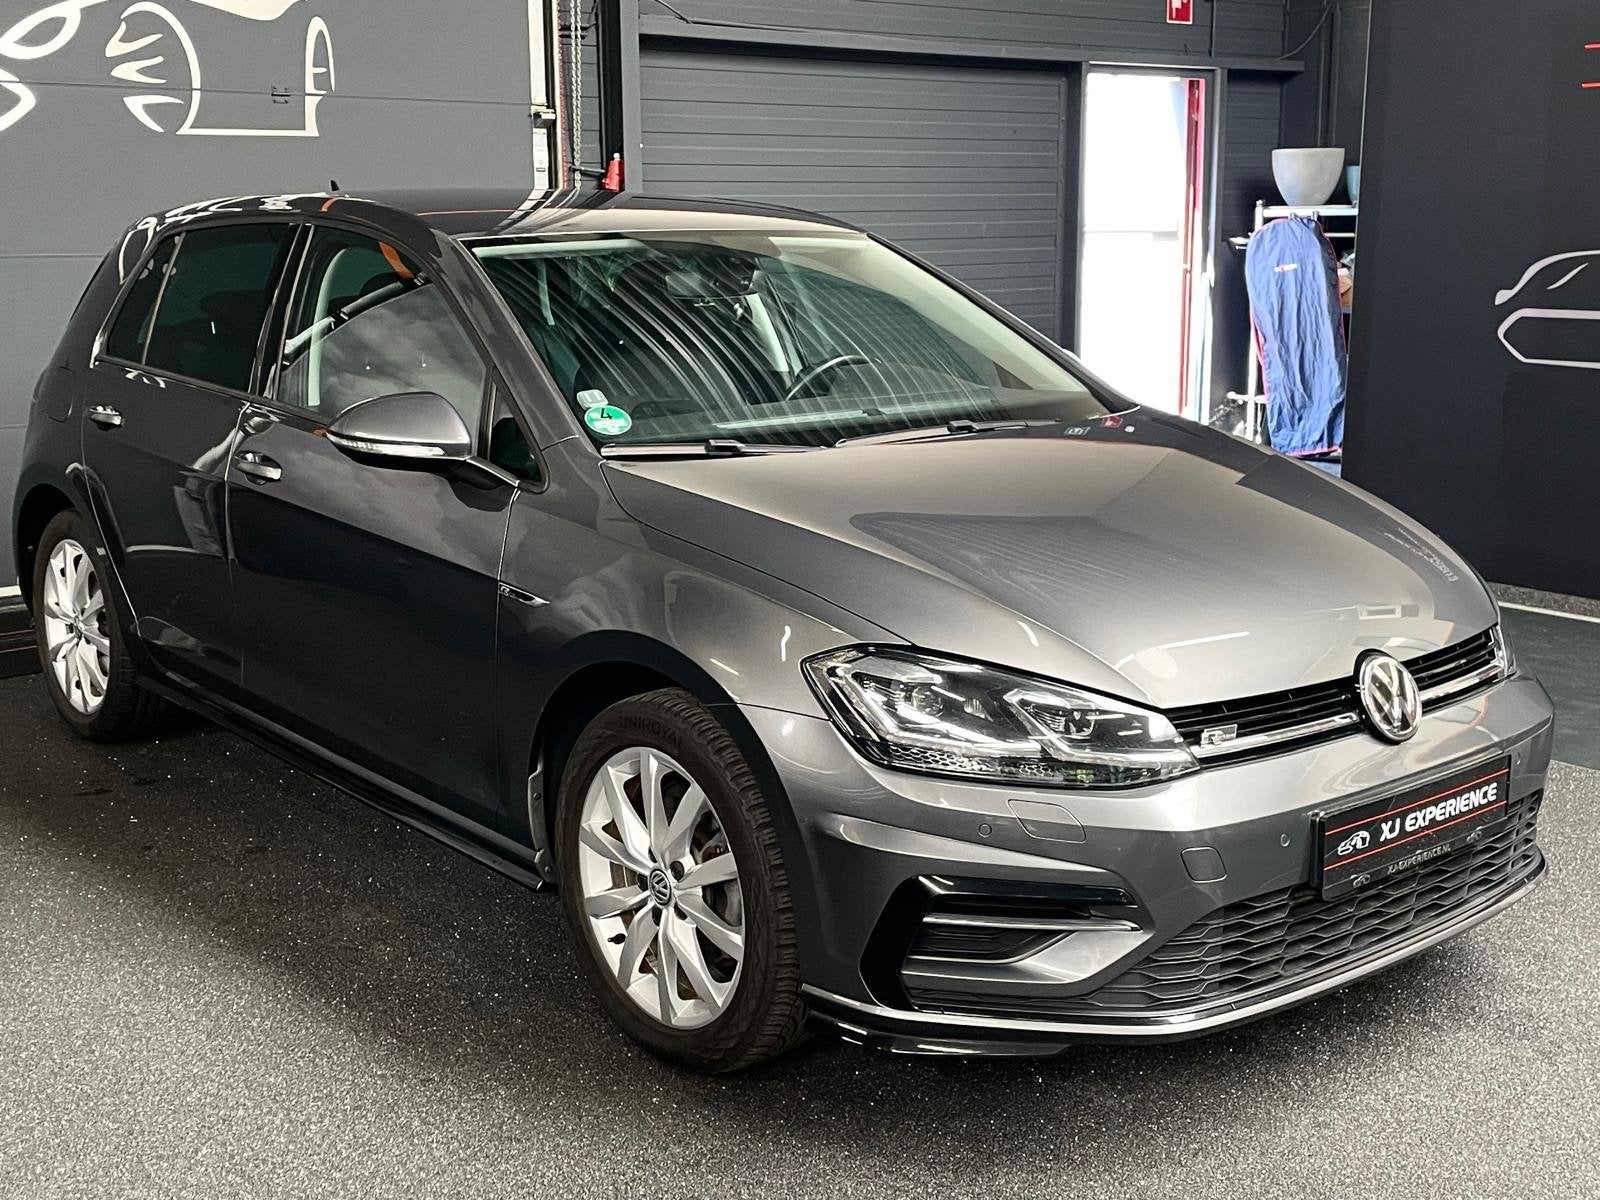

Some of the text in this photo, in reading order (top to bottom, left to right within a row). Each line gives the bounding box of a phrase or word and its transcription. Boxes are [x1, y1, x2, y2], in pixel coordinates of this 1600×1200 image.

[600, 407, 613, 420] 4
[1379, 782, 1498, 843] XJ EXPERIENCE
